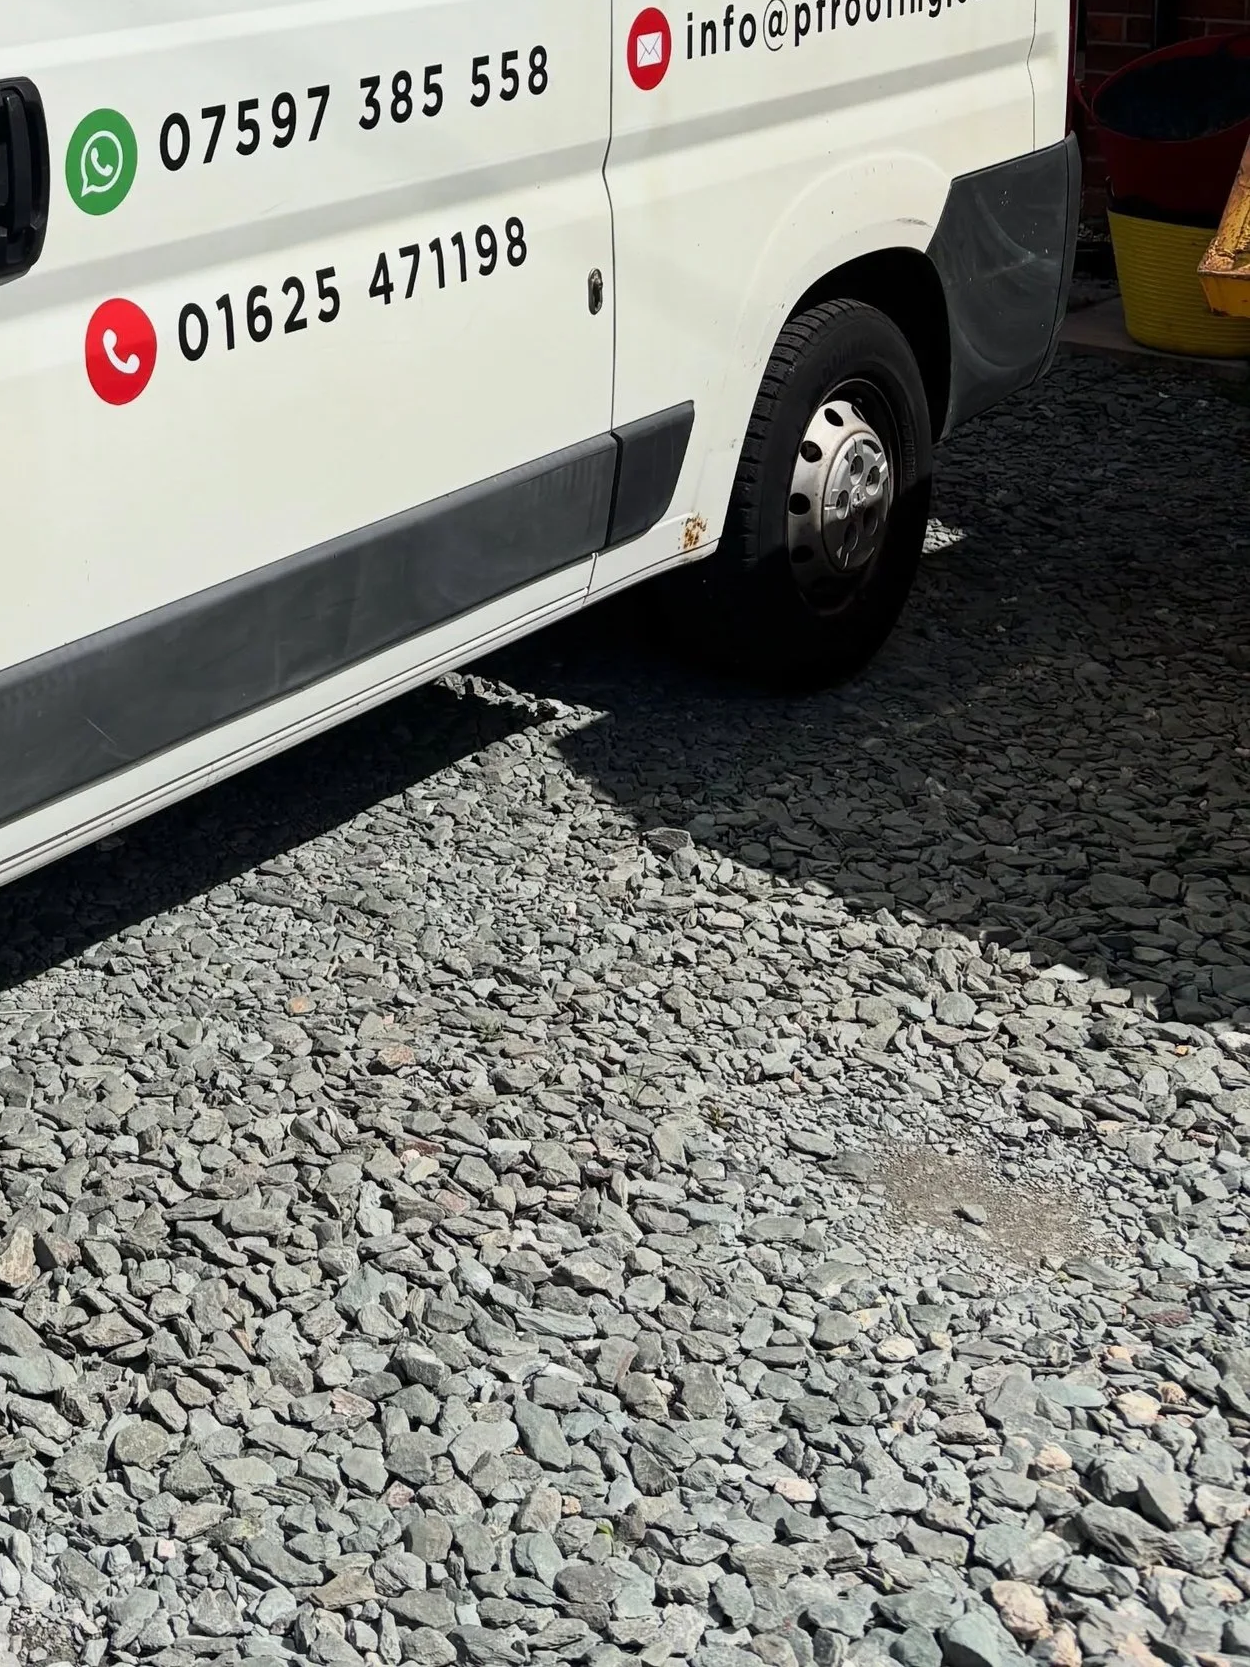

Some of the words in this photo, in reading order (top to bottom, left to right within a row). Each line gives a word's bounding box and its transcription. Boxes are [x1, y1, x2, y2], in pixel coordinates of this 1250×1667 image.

[159, 84, 330, 172] 07597
[358, 63, 444, 131] 385
[469, 45, 549, 108] 558
[178, 266, 341, 362] 01625
[368, 216, 528, 306] 471198
